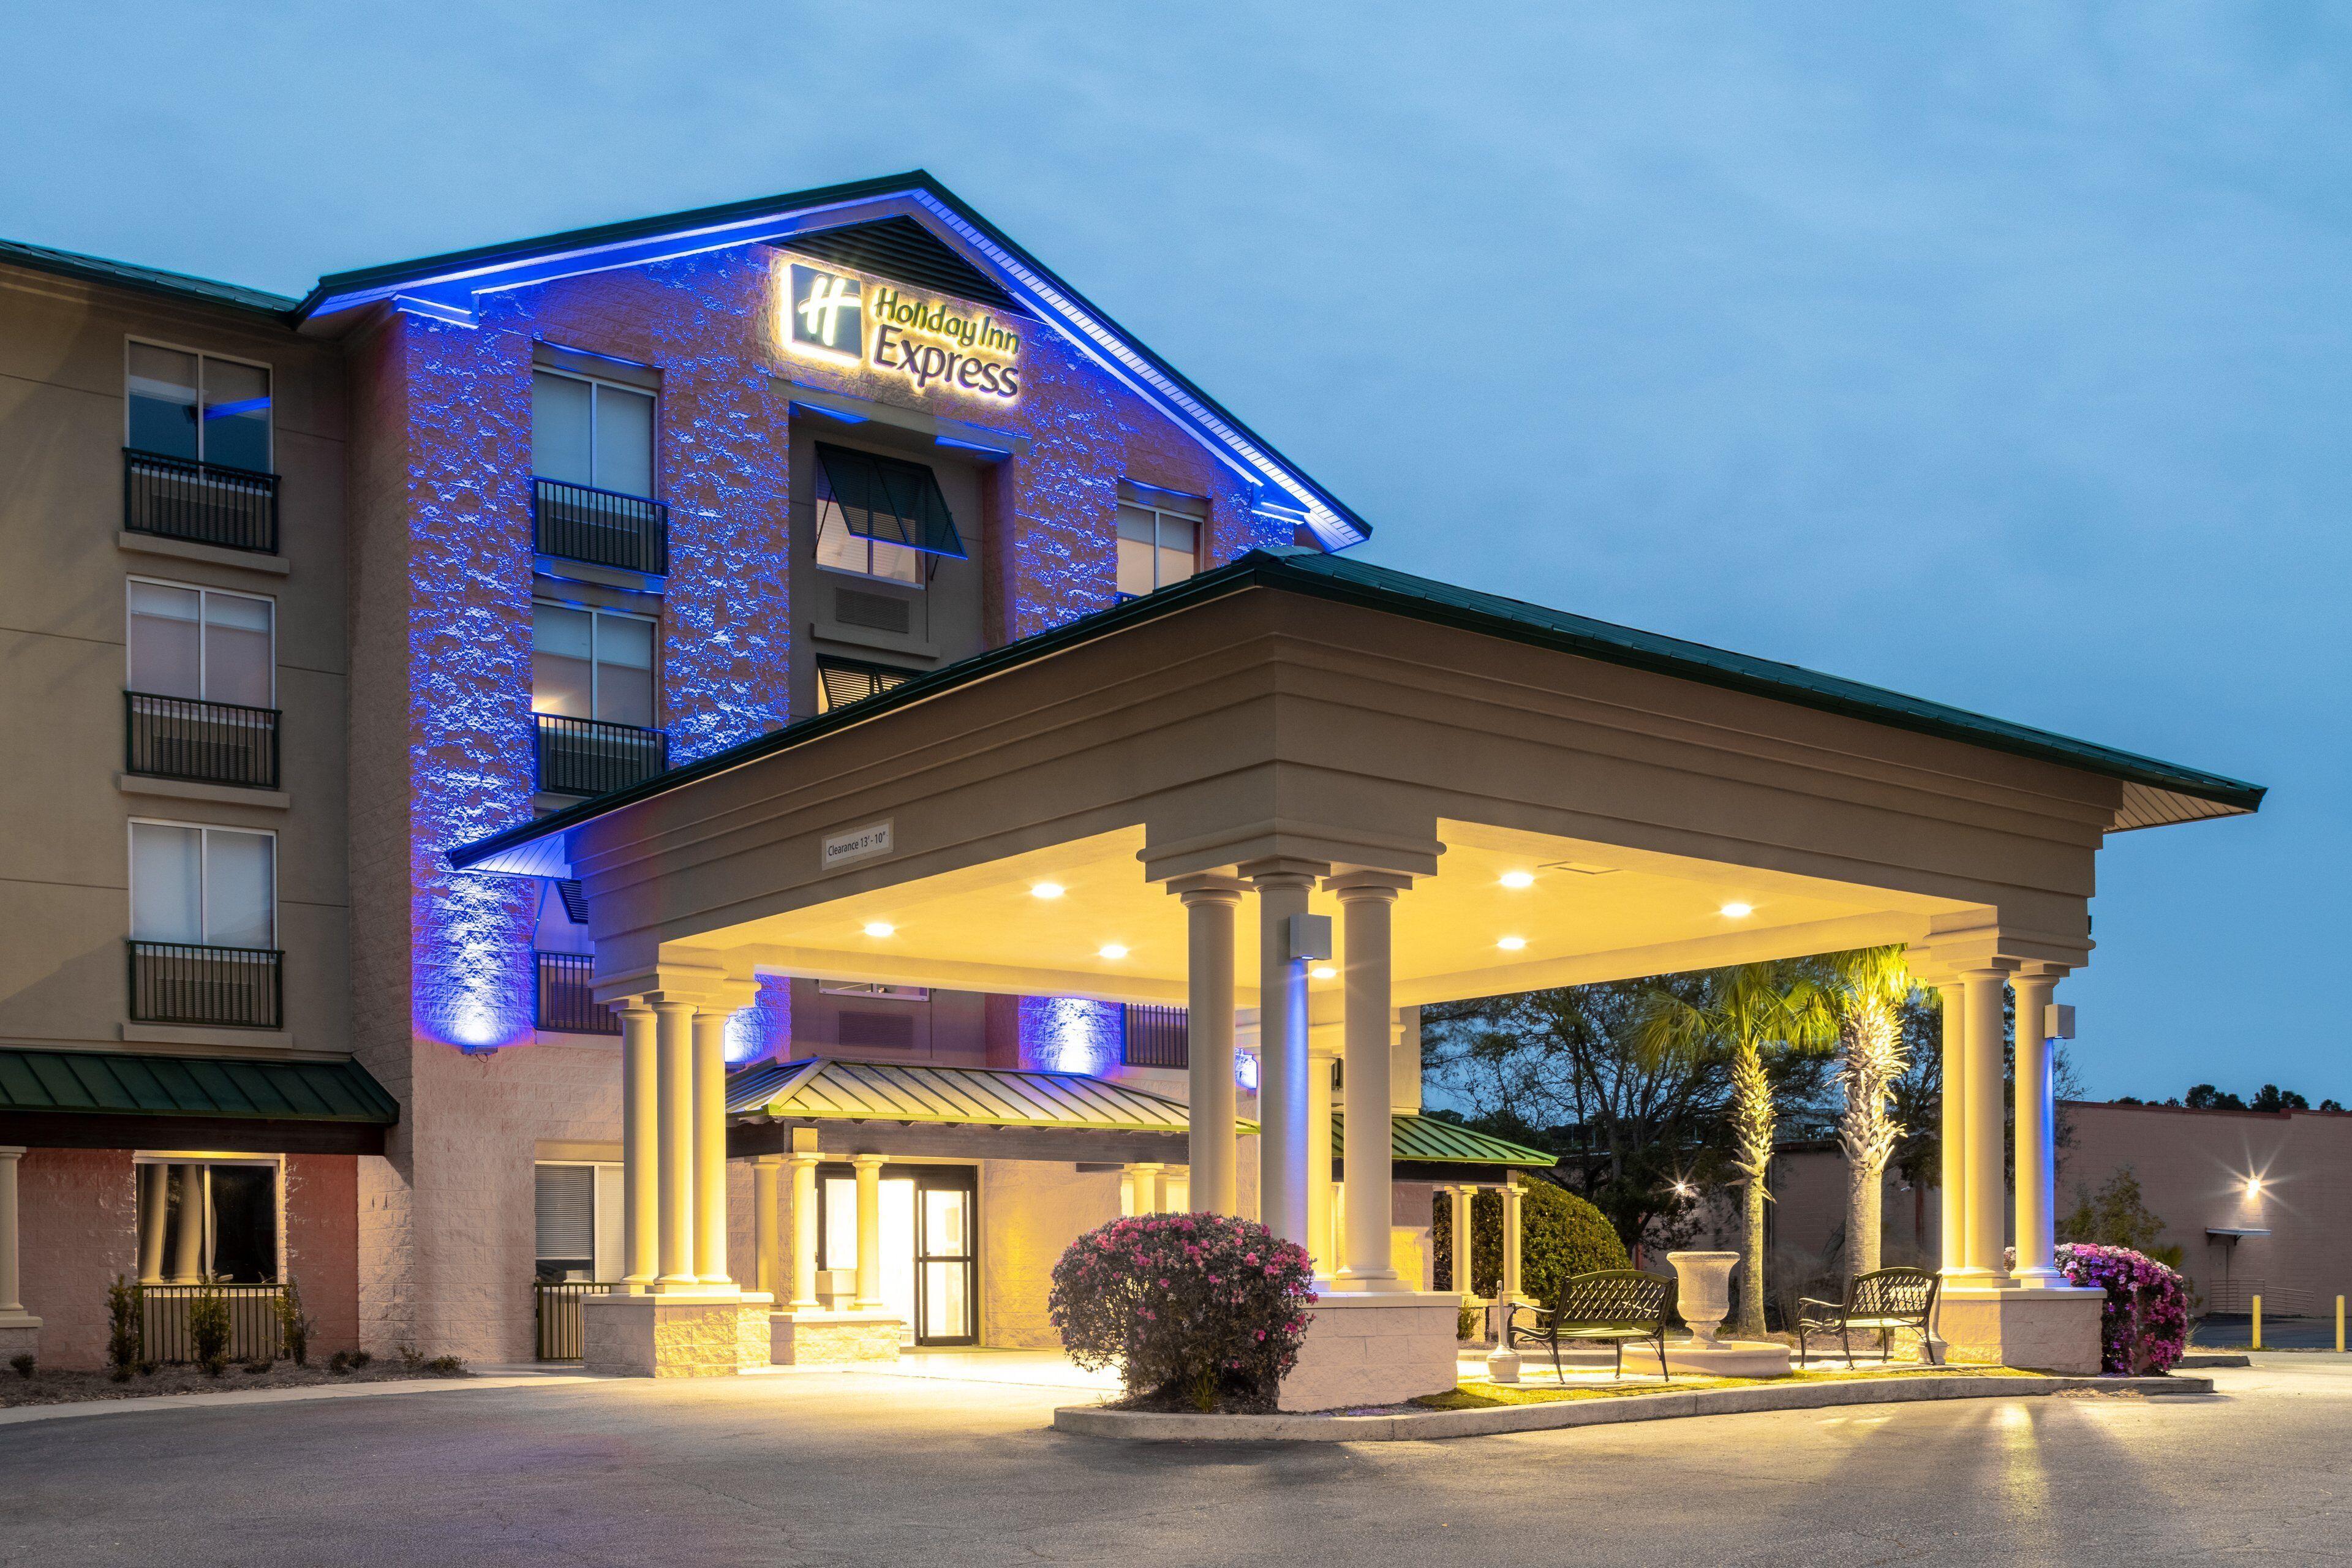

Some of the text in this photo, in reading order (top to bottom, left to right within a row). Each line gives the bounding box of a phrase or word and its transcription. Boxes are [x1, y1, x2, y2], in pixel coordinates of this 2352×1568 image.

[874, 287, 1021, 355] Holiday Inn
[873, 323, 1019, 398] Express
[828, 840, 859, 856] Clearance
